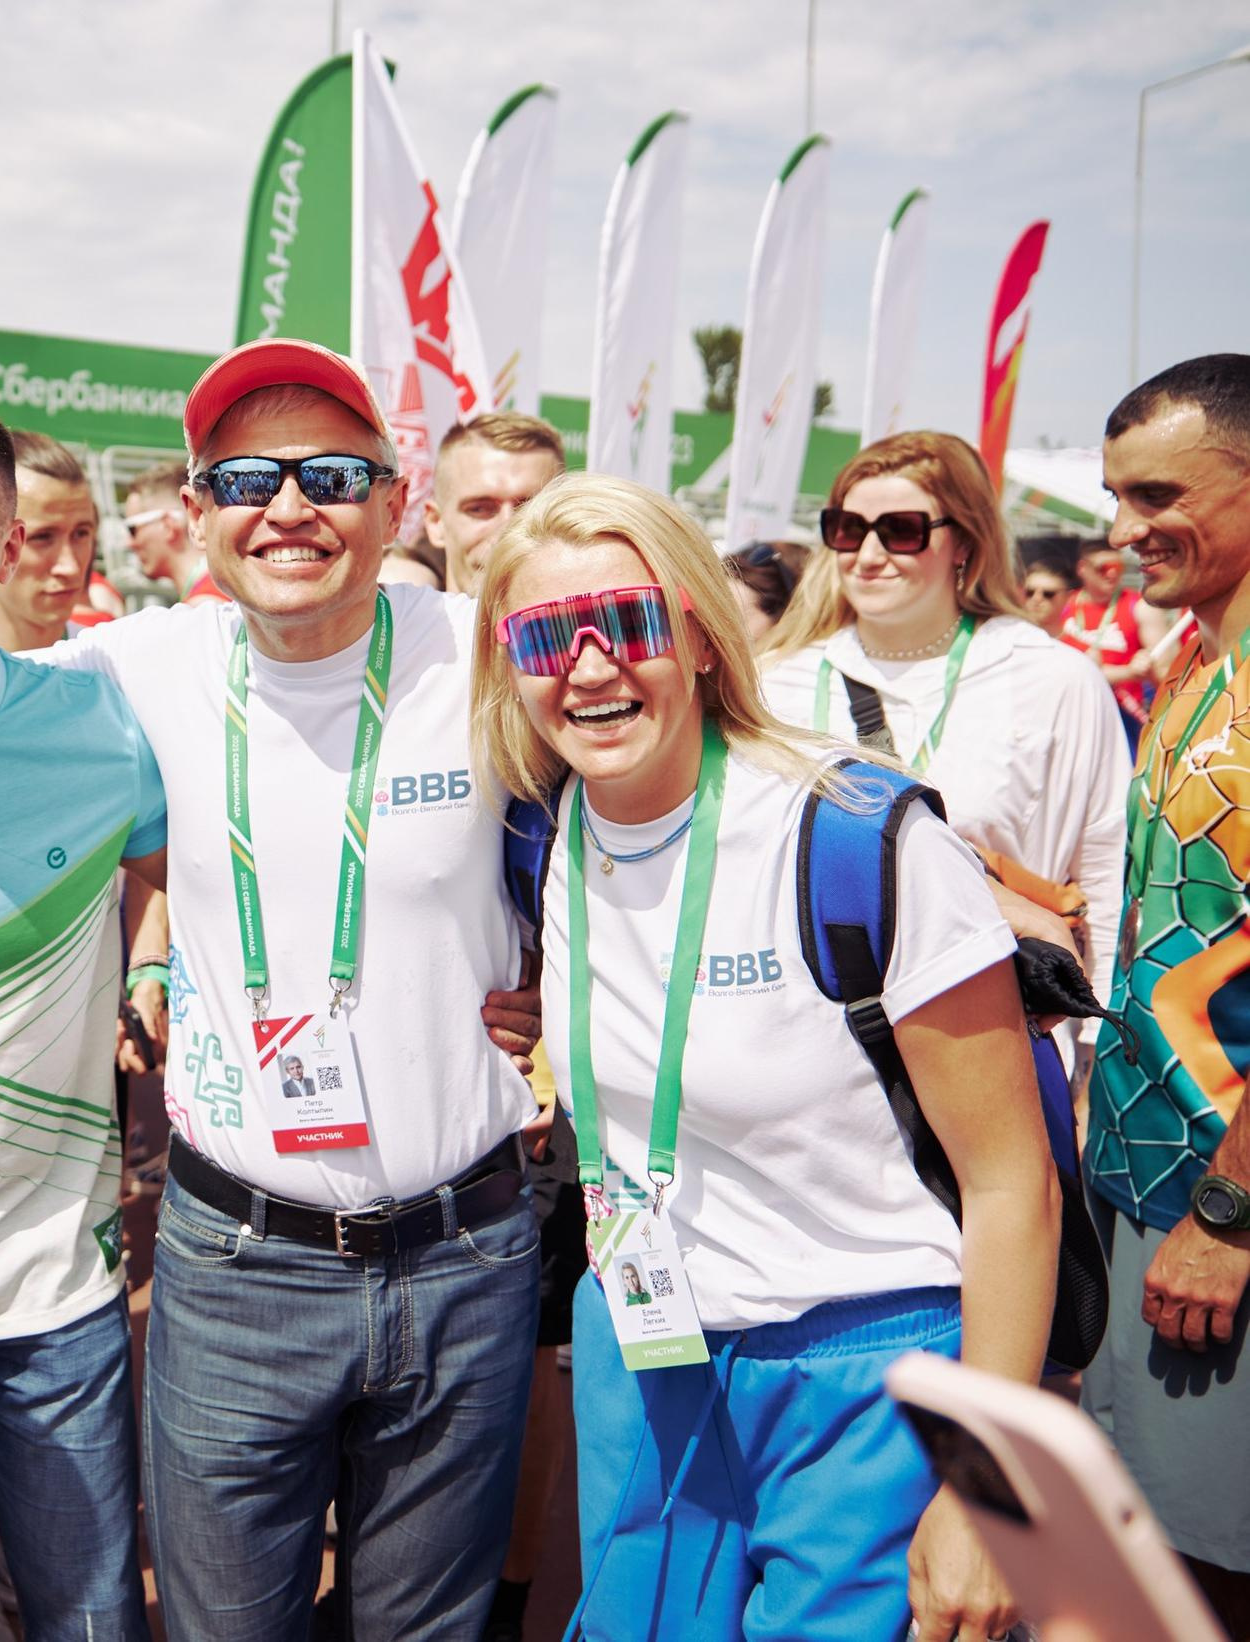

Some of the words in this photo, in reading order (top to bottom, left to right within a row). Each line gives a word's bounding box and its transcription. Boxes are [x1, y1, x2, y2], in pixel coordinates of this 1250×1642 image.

[258, 137, 305, 339] МАНДА!
[358, 722, 375, 790] СБЕРБАНКИАДА
[231, 753, 242, 818] СБЕРБАНКИАДА
[355, 790, 366, 808] 2023
[391, 769, 471, 806] ВВБ
[240, 872, 249, 890] 2023
[342, 861, 356, 929] СБЕРБАНКИАДА
[242, 890, 256, 958] СБЕРБАНКИАДА
[340, 930, 350, 949] 2023
[708, 948, 783, 987] ВВБ
[297, 1131, 344, 1142] УЧАСТНИК
[643, 1346, 684, 1358] УЧАСТНИК
